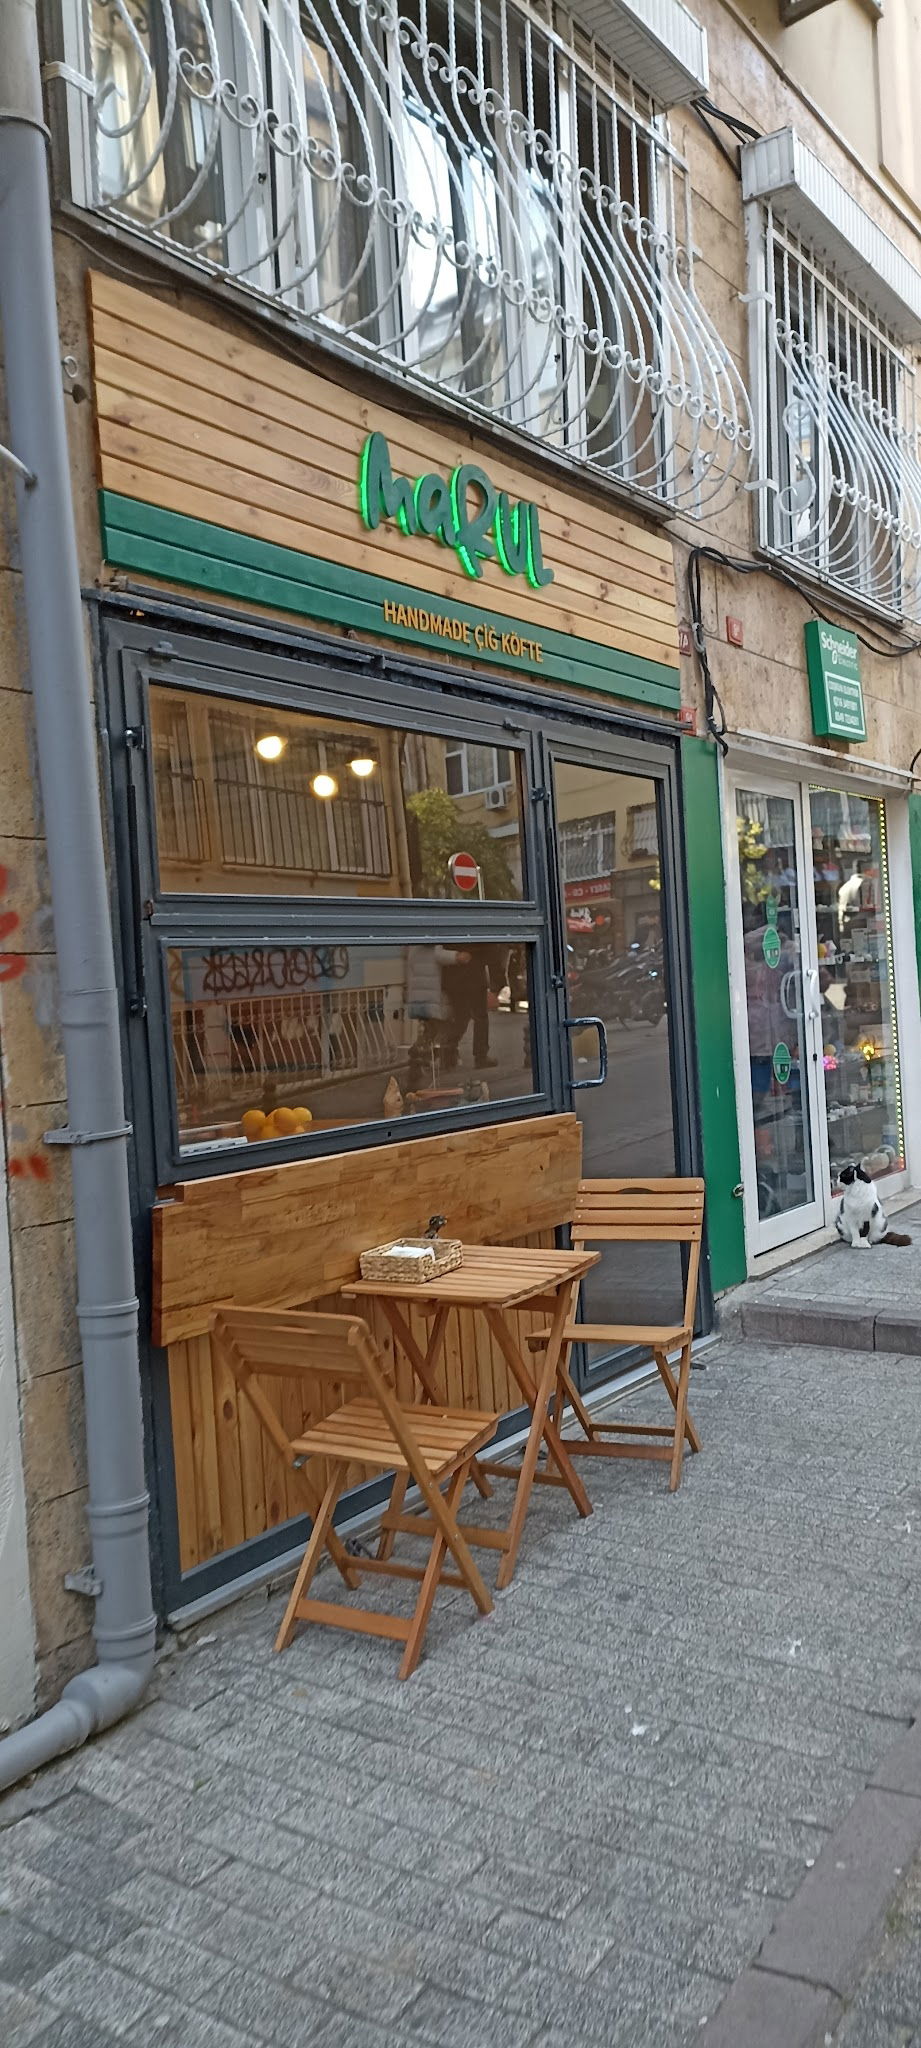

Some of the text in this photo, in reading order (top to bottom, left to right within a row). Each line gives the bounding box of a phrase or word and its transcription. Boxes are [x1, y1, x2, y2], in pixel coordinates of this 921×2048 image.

[383, 599, 544, 663] HANDMADE ÇİĞ KÖFTE
[821, 631, 858, 660] Schneider
